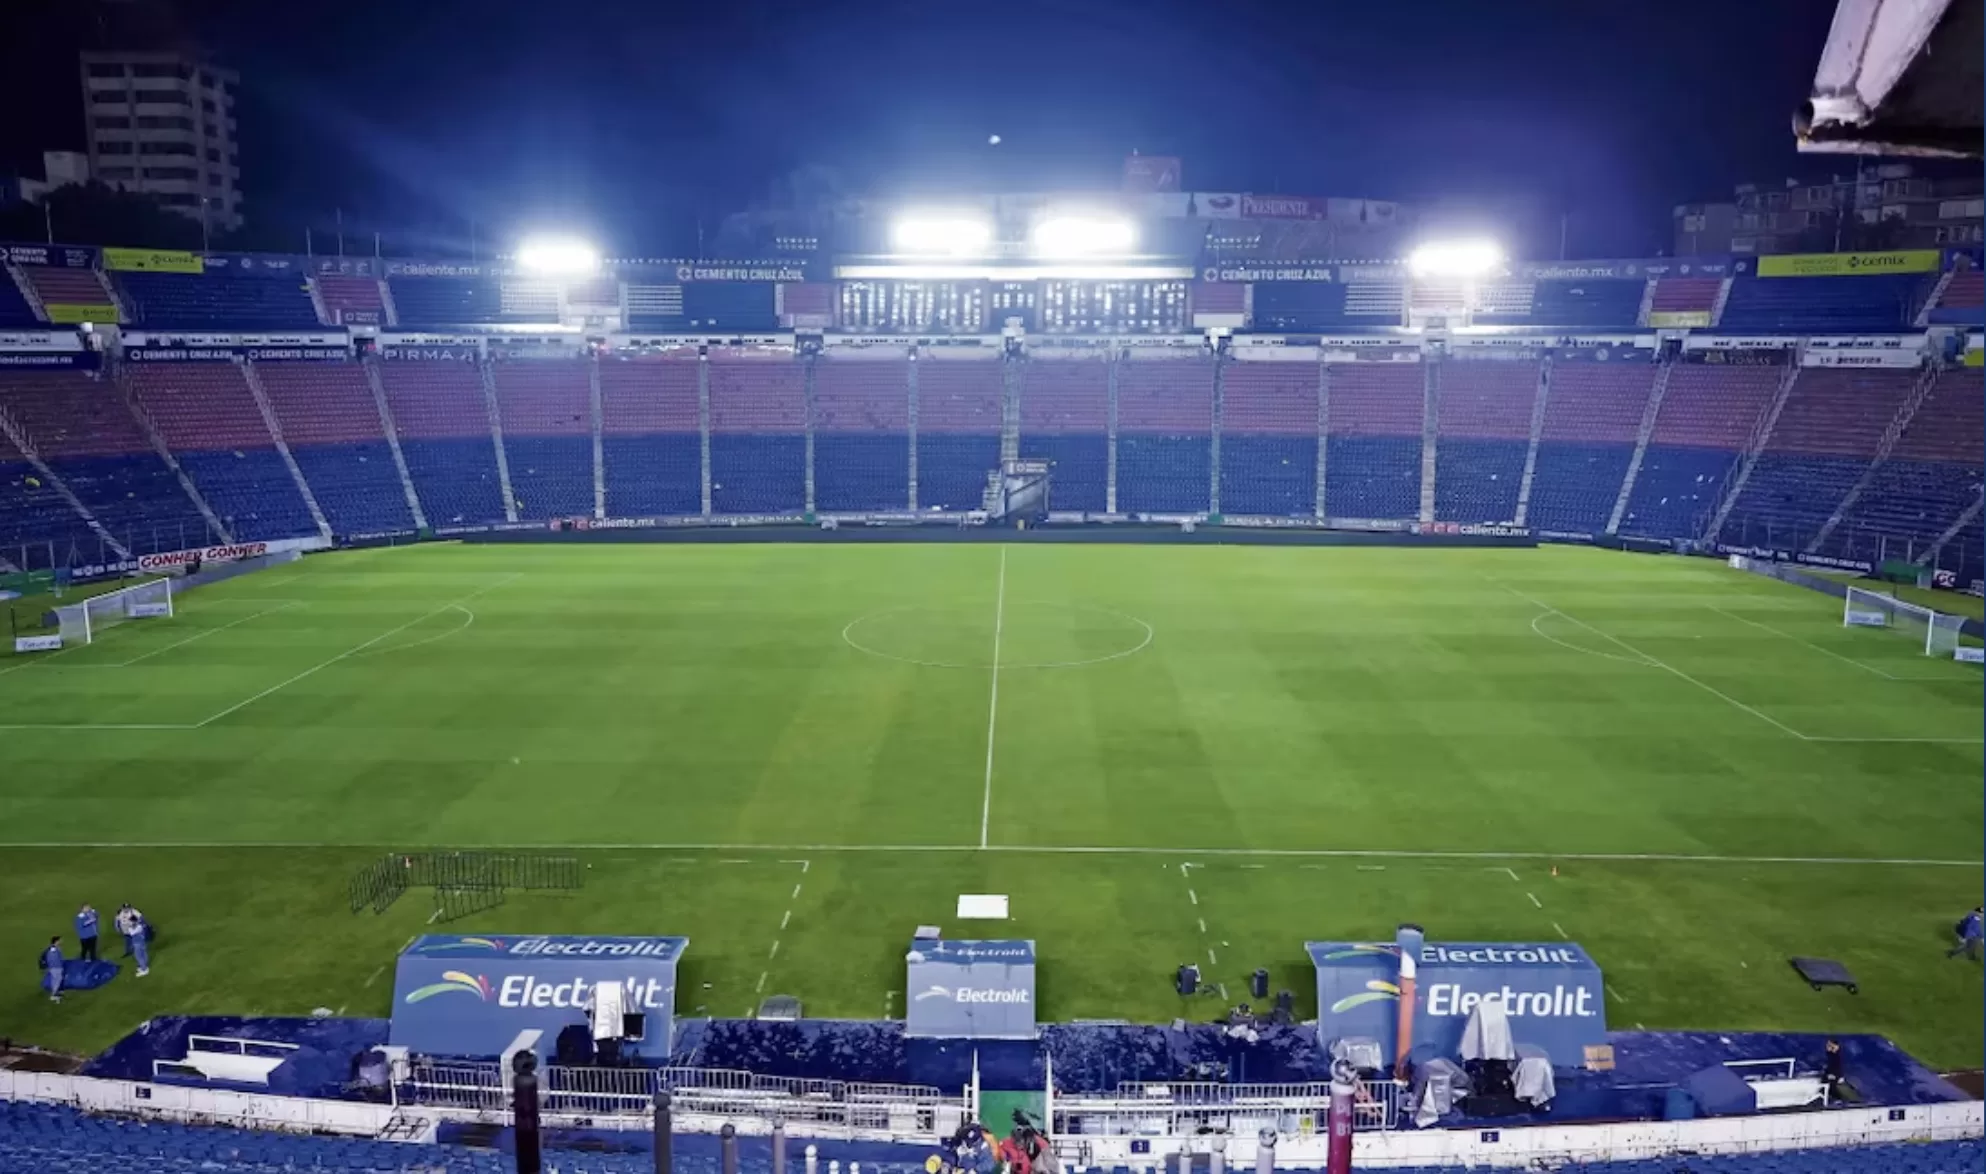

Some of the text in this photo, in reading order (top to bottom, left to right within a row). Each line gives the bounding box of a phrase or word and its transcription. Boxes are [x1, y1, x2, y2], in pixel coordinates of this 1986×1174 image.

[694, 268, 748, 280] CEMENTO
[749, 268, 776, 280] CRUZ
[1221, 269, 1332, 282] CEMENTO CRUZ AZUL
[384, 350, 454, 360] PIRMA
[589, 517, 656, 529] caliente.mx
[1460, 523, 1530, 537] caliente.mx
[140, 551, 202, 567] GONHER
[508, 939, 668, 956] Electrolit
[1421, 946, 1577, 963] Electrolit
[498, 975, 664, 1008] Electlit
[956, 987, 1029, 1003] Electrolit
